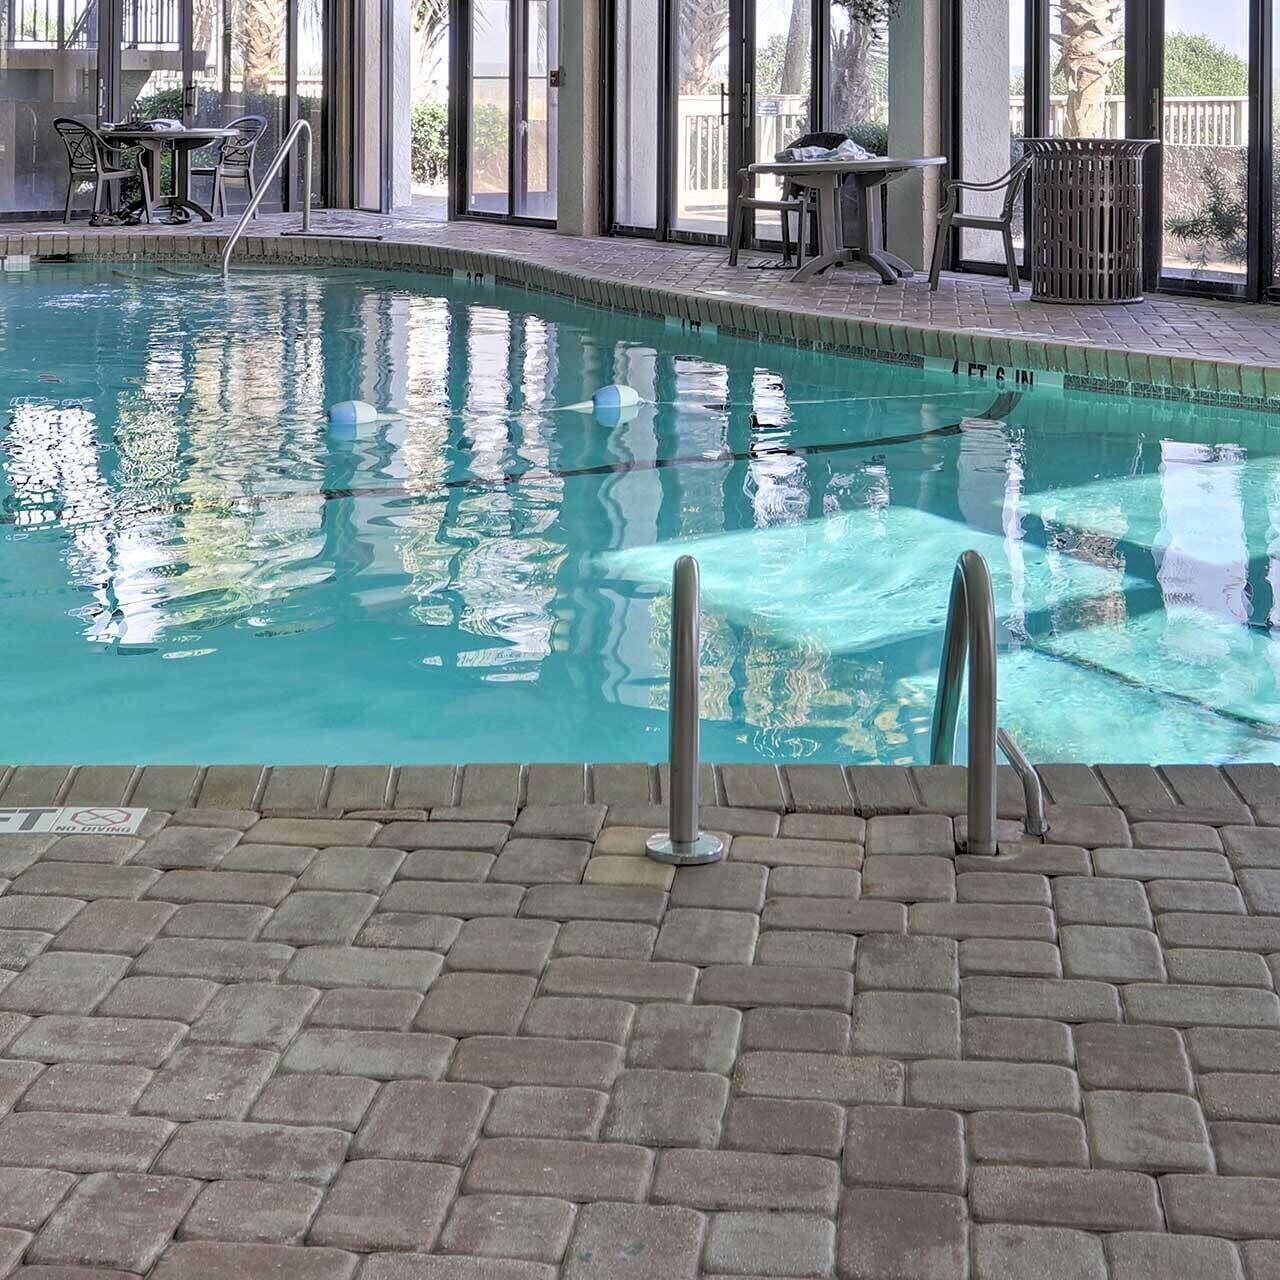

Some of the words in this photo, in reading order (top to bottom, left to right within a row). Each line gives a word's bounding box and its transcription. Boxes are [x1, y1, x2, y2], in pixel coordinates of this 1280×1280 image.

[968, 363, 988, 379] FT
[995, 367, 1005, 381] 6
[1015, 369, 1034, 385] IN
